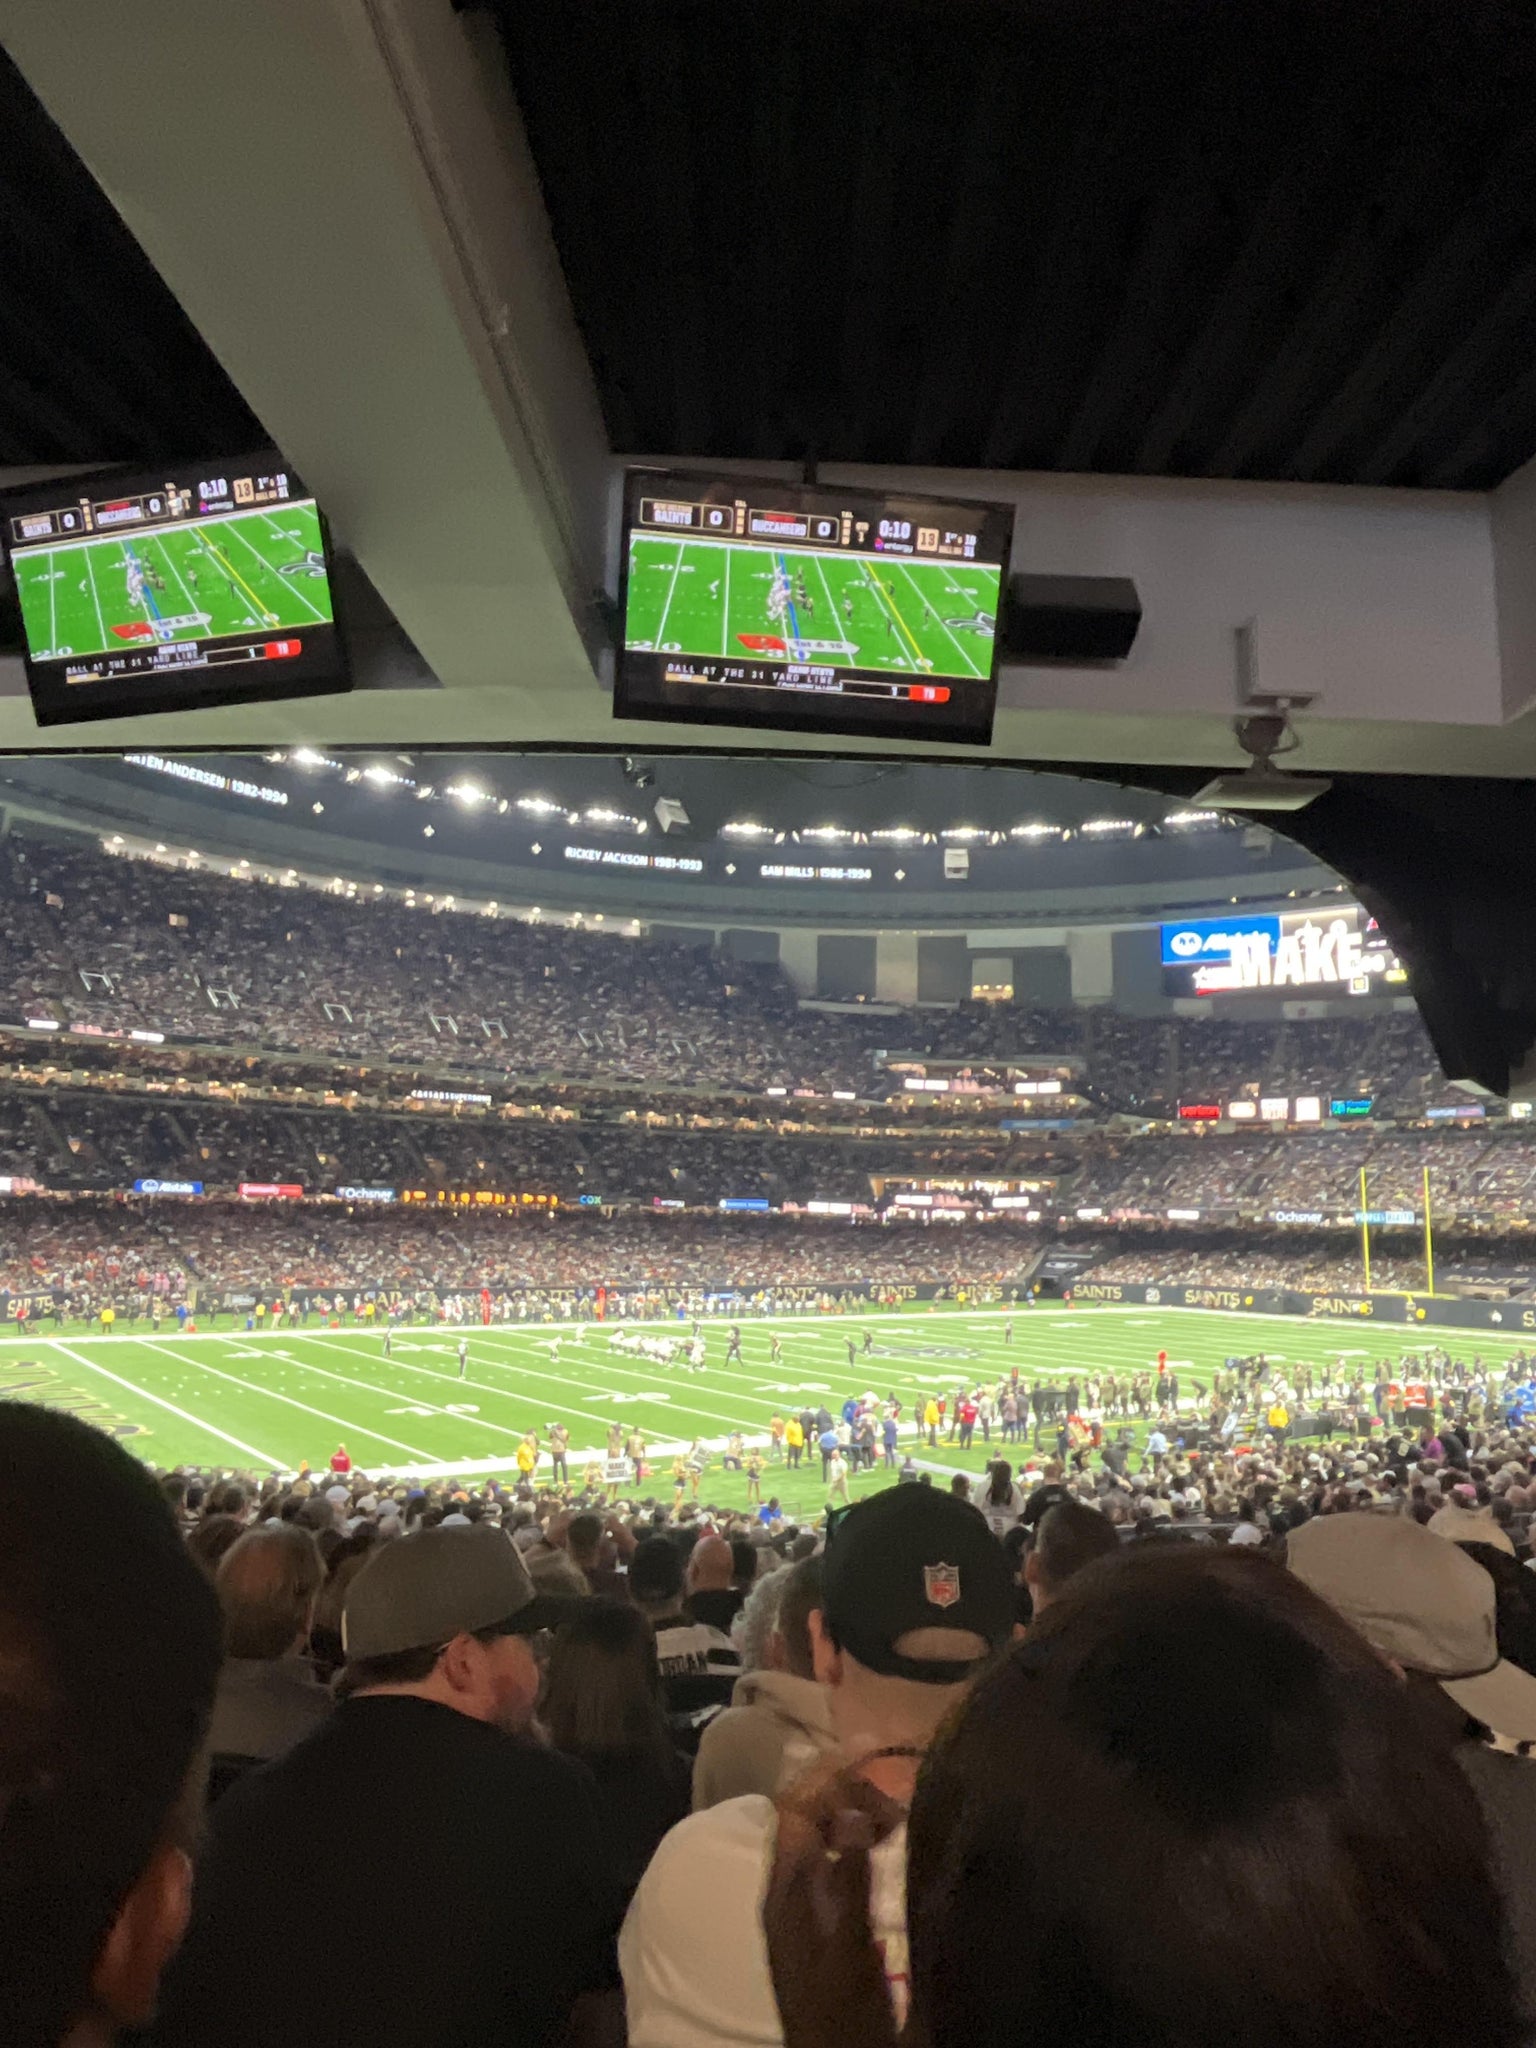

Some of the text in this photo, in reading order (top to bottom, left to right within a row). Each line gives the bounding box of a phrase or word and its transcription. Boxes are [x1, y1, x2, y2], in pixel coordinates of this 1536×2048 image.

[198, 478, 228, 499] 0:10
[237, 482, 251, 497] 13
[879, 519, 911, 539] 0:10
[921, 532, 936, 547] 13
[66, 664, 87, 675] BALL
[92, 662, 104, 672] AT
[666, 663, 696, 674] BALL
[702, 665, 717, 675] AT
[723, 667, 745, 679] THE
[772, 672, 801, 683] YARD
[806, 675, 834, 685] LINE
[163, 761, 226, 789] ANDERSEN
[565, 846, 602, 861] RICKEY
[602, 852, 649, 867] JACKSON
[761, 865, 784, 877] SAM
[784, 865, 814, 878] MILLS
[158, 1181, 194, 1193] Allstate
[345, 1187, 393, 1200] Ochsner
[579, 1195, 602, 1206] COX
[1275, 1210, 1322, 1223] Ochsner
[1073, 1284, 1122, 1299] SAINTS
[1145, 1286, 1160, 1305] 20
[1185, 1288, 1240, 1307] SAINTS
[1312, 1297, 1373, 1316] SAINS
